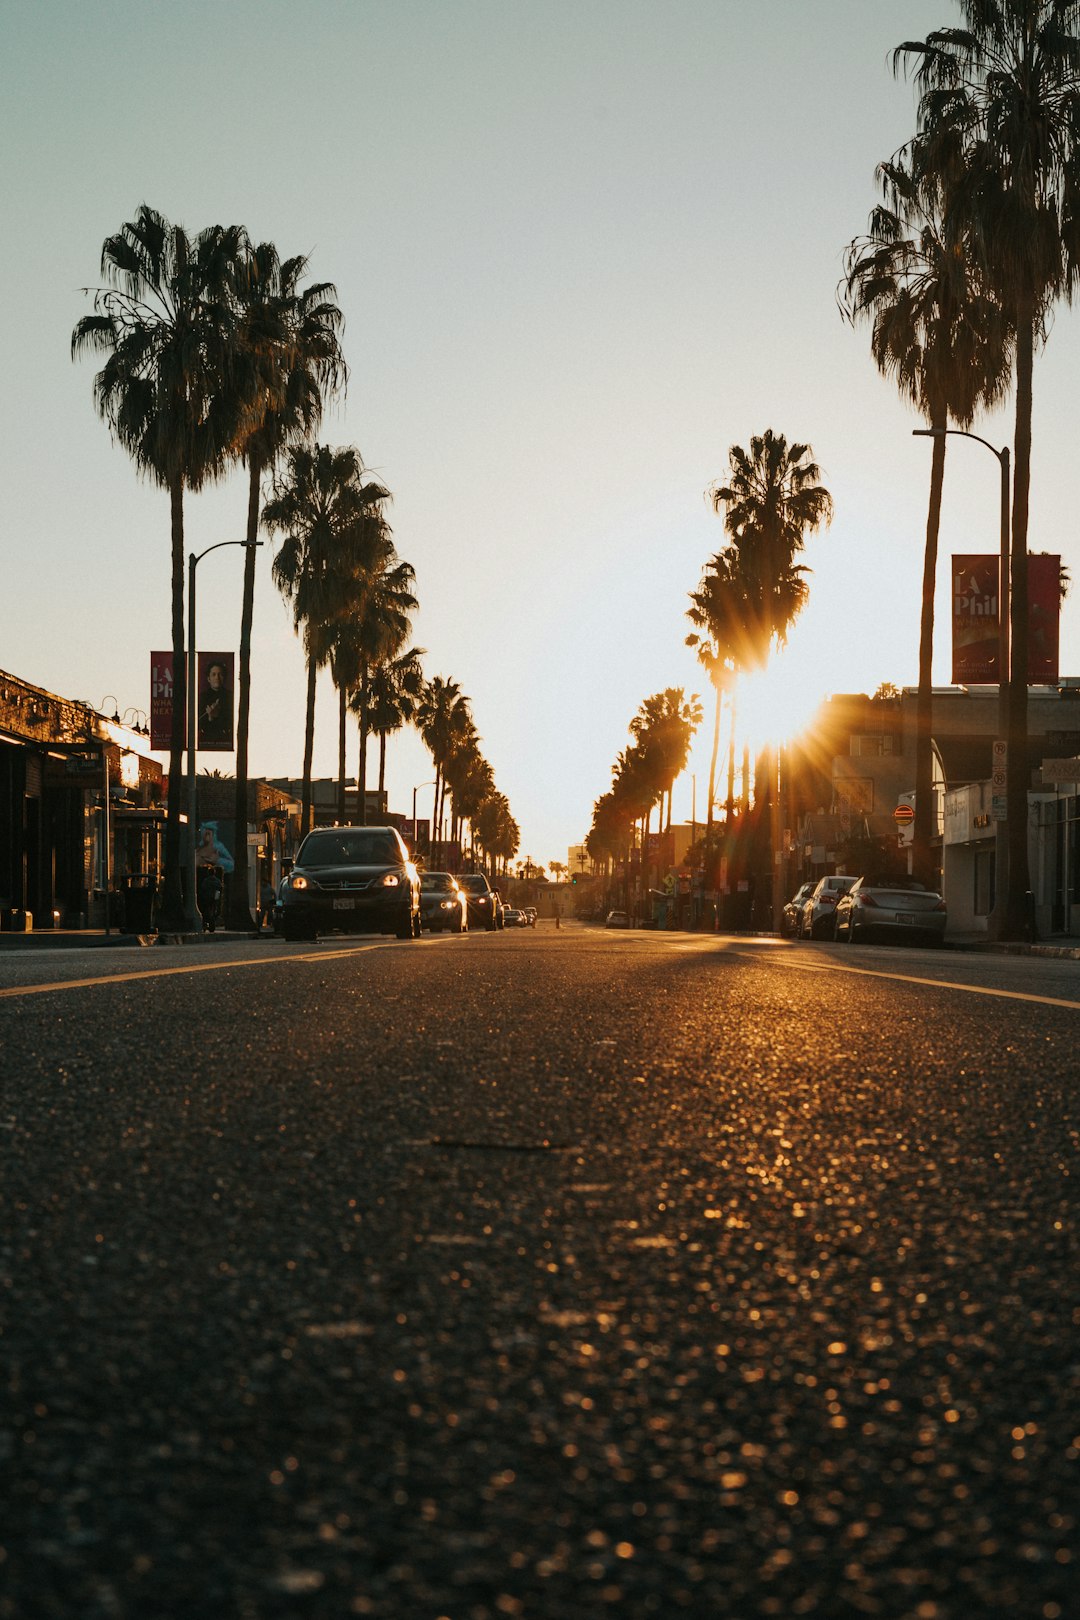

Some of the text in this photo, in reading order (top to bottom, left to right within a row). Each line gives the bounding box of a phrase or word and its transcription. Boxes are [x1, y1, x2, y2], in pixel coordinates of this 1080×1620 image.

[955, 575, 981, 595] LA
[955, 594, 997, 616] Phil
[153, 682, 173, 698] Ph
